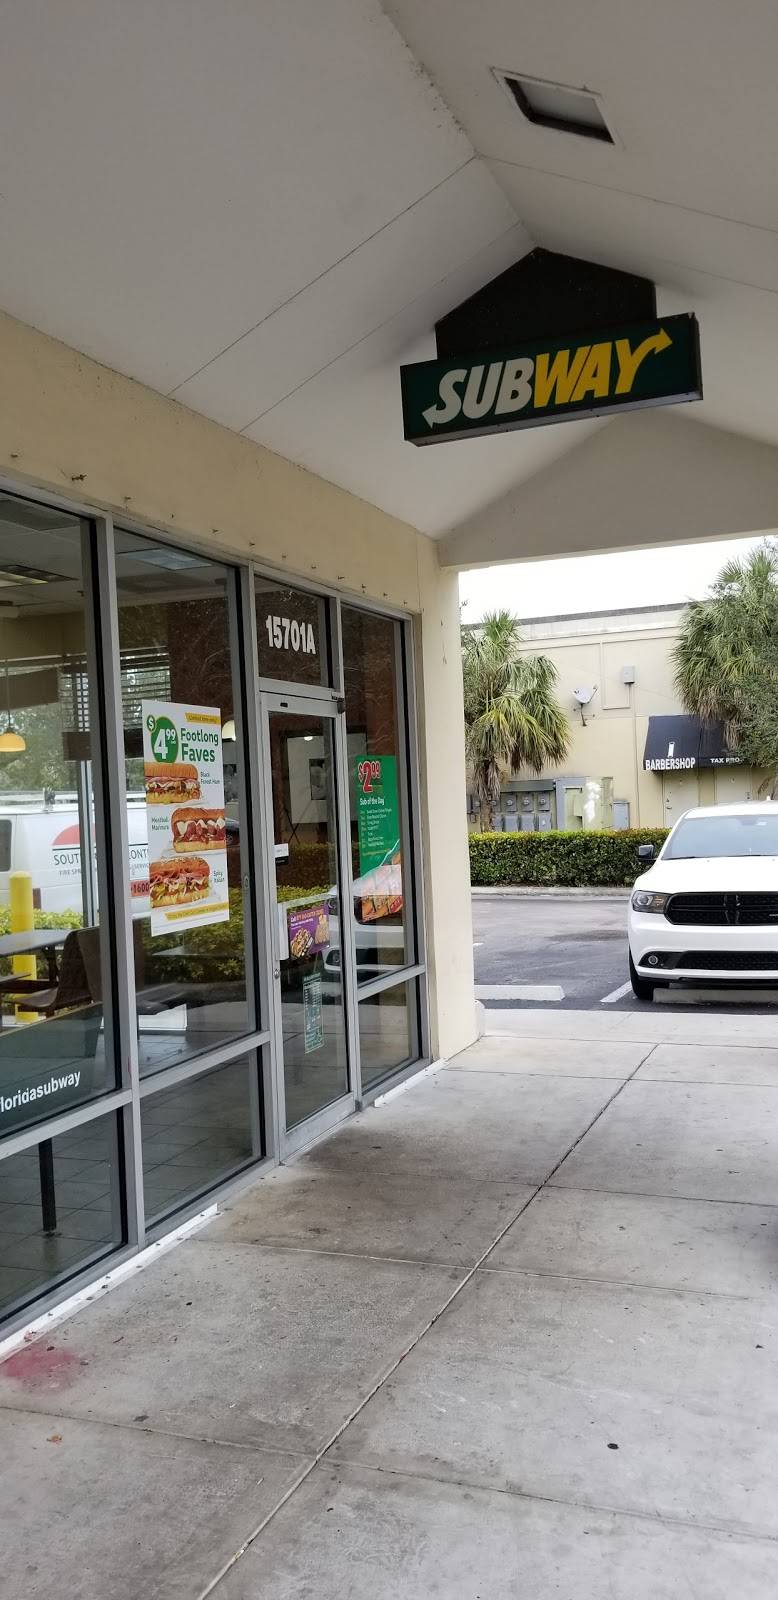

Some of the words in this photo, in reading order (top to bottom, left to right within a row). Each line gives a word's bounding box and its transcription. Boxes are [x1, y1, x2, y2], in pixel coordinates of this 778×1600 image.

[422, 328, 673, 428] SUBWAY
[265, 614, 316, 655] 15701A
[180, 727, 219, 747] Footlong
[181, 743, 216, 763] Faves
[645, 757, 696, 770] BARBERSHOP
[53, 853, 80, 866] SOUT
[0, 1071, 81, 1113] loridasubway
